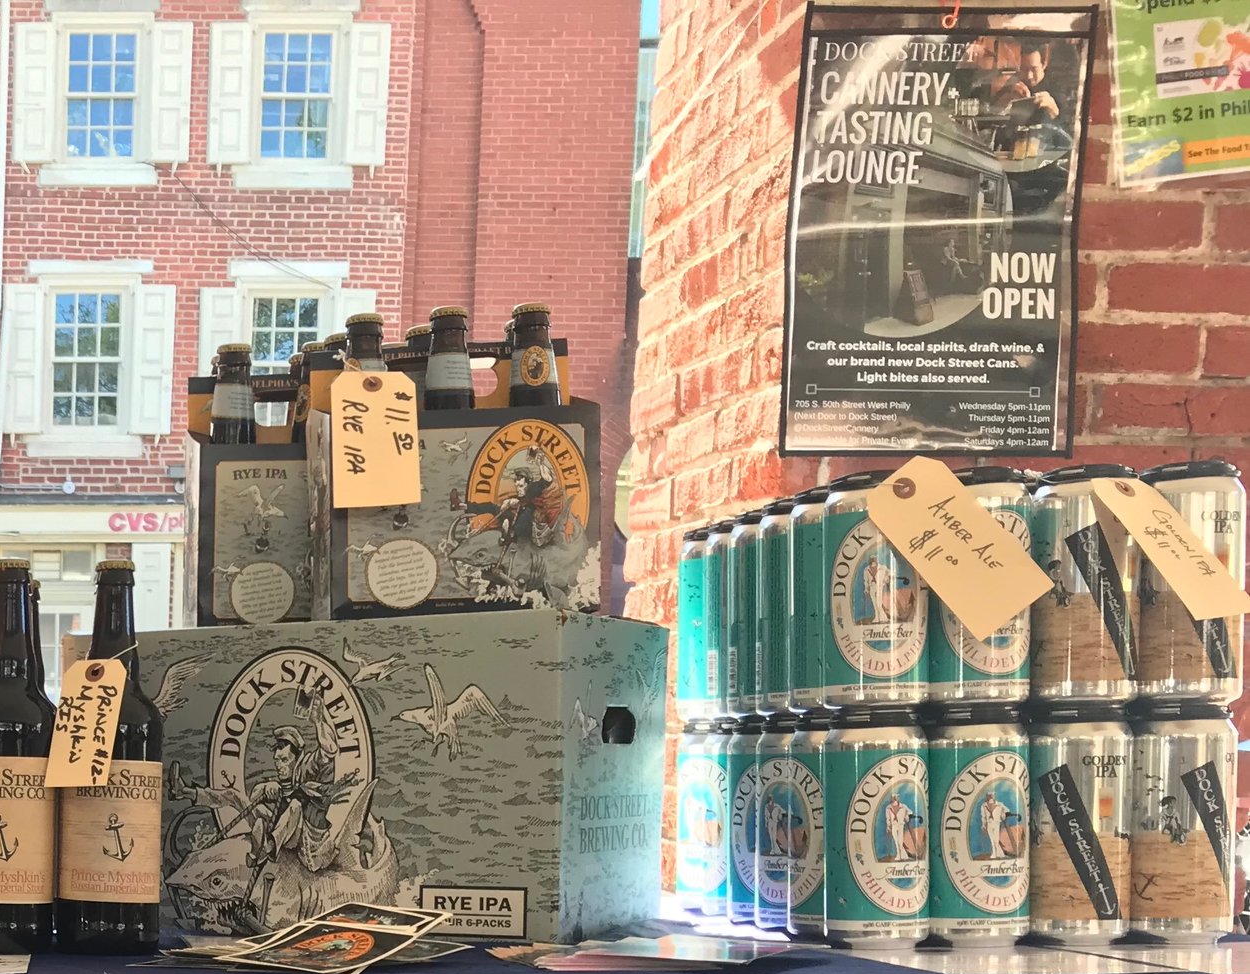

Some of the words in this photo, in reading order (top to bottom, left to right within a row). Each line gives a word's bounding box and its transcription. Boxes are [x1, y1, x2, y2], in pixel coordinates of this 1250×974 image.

[824, 41, 891, 62] DOC
[896, 42, 980, 63] STREET
[1127, 113, 1166, 128] Earn
[1172, 107, 1193, 124] $2
[1199, 105, 1215, 119] in
[816, 110, 933, 145] TASTING
[1188, 150, 1202, 158] See
[1205, 148, 1219, 156] The
[1222, 145, 1242, 154] Food
[811, 150, 924, 185] LOUNGE
[990, 252, 1056, 284] NOW
[983, 287, 1055, 320] OPEN
[806, 341, 837, 351] Craft
[839, 341, 895, 352] cocktails,
[896, 342, 925, 352] local
[927, 342, 967, 354] spirits,
[969, 342, 1000, 352] draft
[1001, 343, 1034, 354] wine,
[1036, 343, 1045, 353] &
[827, 358, 848, 367] our
[850, 356, 886, 367] brand
[887, 358, 914, 367] new
[915, 357, 946, 368] Dock
[948, 357, 986, 369] Street
[987, 358, 1019, 369] Cans.
[857, 372, 888, 385] Light
[890, 372, 919, 383] bites
[921, 373, 946, 384] also
[947, 373, 990, 384] served.
[795, 400, 810, 408] 705
[822, 400, 840, 409] 50th
[842, 400, 866, 409] Street
[867, 401, 888, 410] West
[889, 401, 911, 411] Philly
[959, 402, 1006, 412] Wednesday
[1007, 402, 1051, 413] 5pm-11pm
[342, 399, 370, 436] RYE
[817, 412, 837, 421] Door
[839, 412, 847, 421] to
[848, 412, 869, 421] Dock
[870, 413, 898, 422] Street)
[968, 413, 1006, 424] Thursday
[1007, 414, 1051, 424] 5pm-11pm
[980, 425, 1006, 436] Friday
[1007, 426, 1050, 436] 4pm-12am
[964, 437, 1005, 448] Saturdays
[1006, 437, 1049, 448] 4pm-12am
[343, 445, 366, 475] IPA
[475, 431, 518, 495] DOCK
[521, 424, 582, 495] STREET
[233, 467, 262, 481] RYE
[266, 467, 288, 481] IPA
[928, 495, 973, 545] AMBER
[971, 542, 1005, 569] ALE
[1214, 521, 1235, 534] IPA
[833, 528, 873, 598] DOCK
[219, 668, 277, 761] DOCK
[280, 659, 362, 760] STREET
[1082, 754, 1127, 767] GOLDEN
[1, 768, 46, 786] STREE
[118, 769, 162, 787] STREET
[1096, 765, 1119, 779] IPA
[26, 786, 46, 800] CO.
[76, 786, 141, 800] BREWING
[142, 787, 158, 801] CO.
[945, 764, 990, 832] DOCK
[1048, 771, 1076, 817] DOCK
[1194, 768, 1220, 814] DOCK
[580, 795, 611, 821] DOCK
[612, 794, 648, 819] STREET
[851, 766, 894, 835] DOCK
[579, 823, 630, 855] BREWING
[1068, 817, 1101, 883] STREET
[71, 868, 106, 881] Prince
[433, 895, 472, 911] RYE
[479, 896, 512, 912] IPA
[465, 919, 512, 929] 6-PACKS
